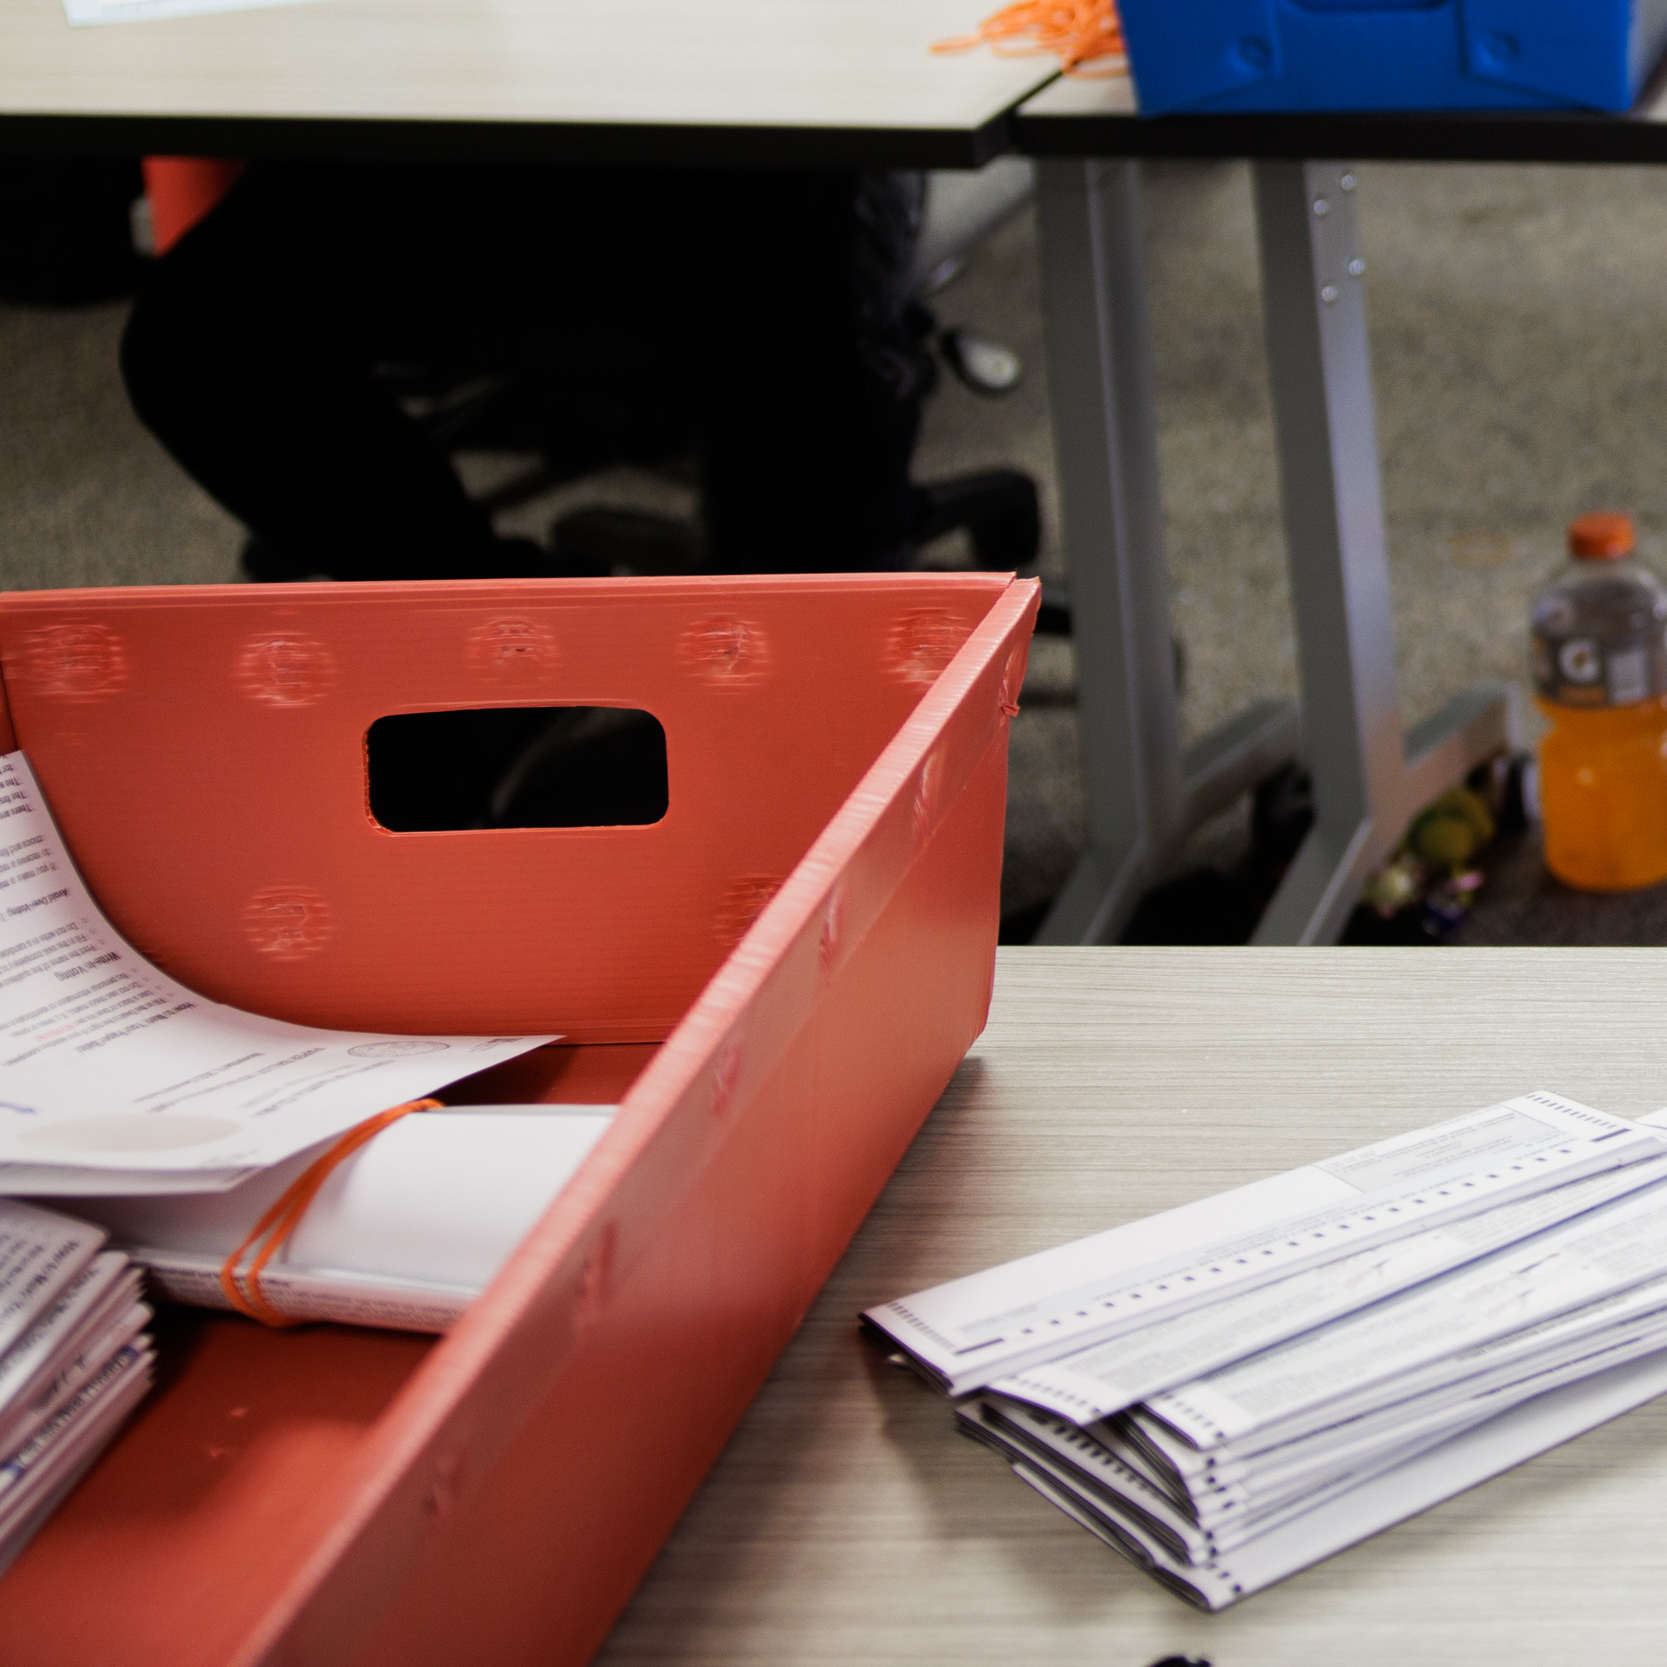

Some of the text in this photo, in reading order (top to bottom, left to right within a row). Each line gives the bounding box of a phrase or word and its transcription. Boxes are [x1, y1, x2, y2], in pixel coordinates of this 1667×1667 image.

[6, 887, 68, 918] Avoid Over-Voting
[53, 949, 120, 983] Write-In Voting
